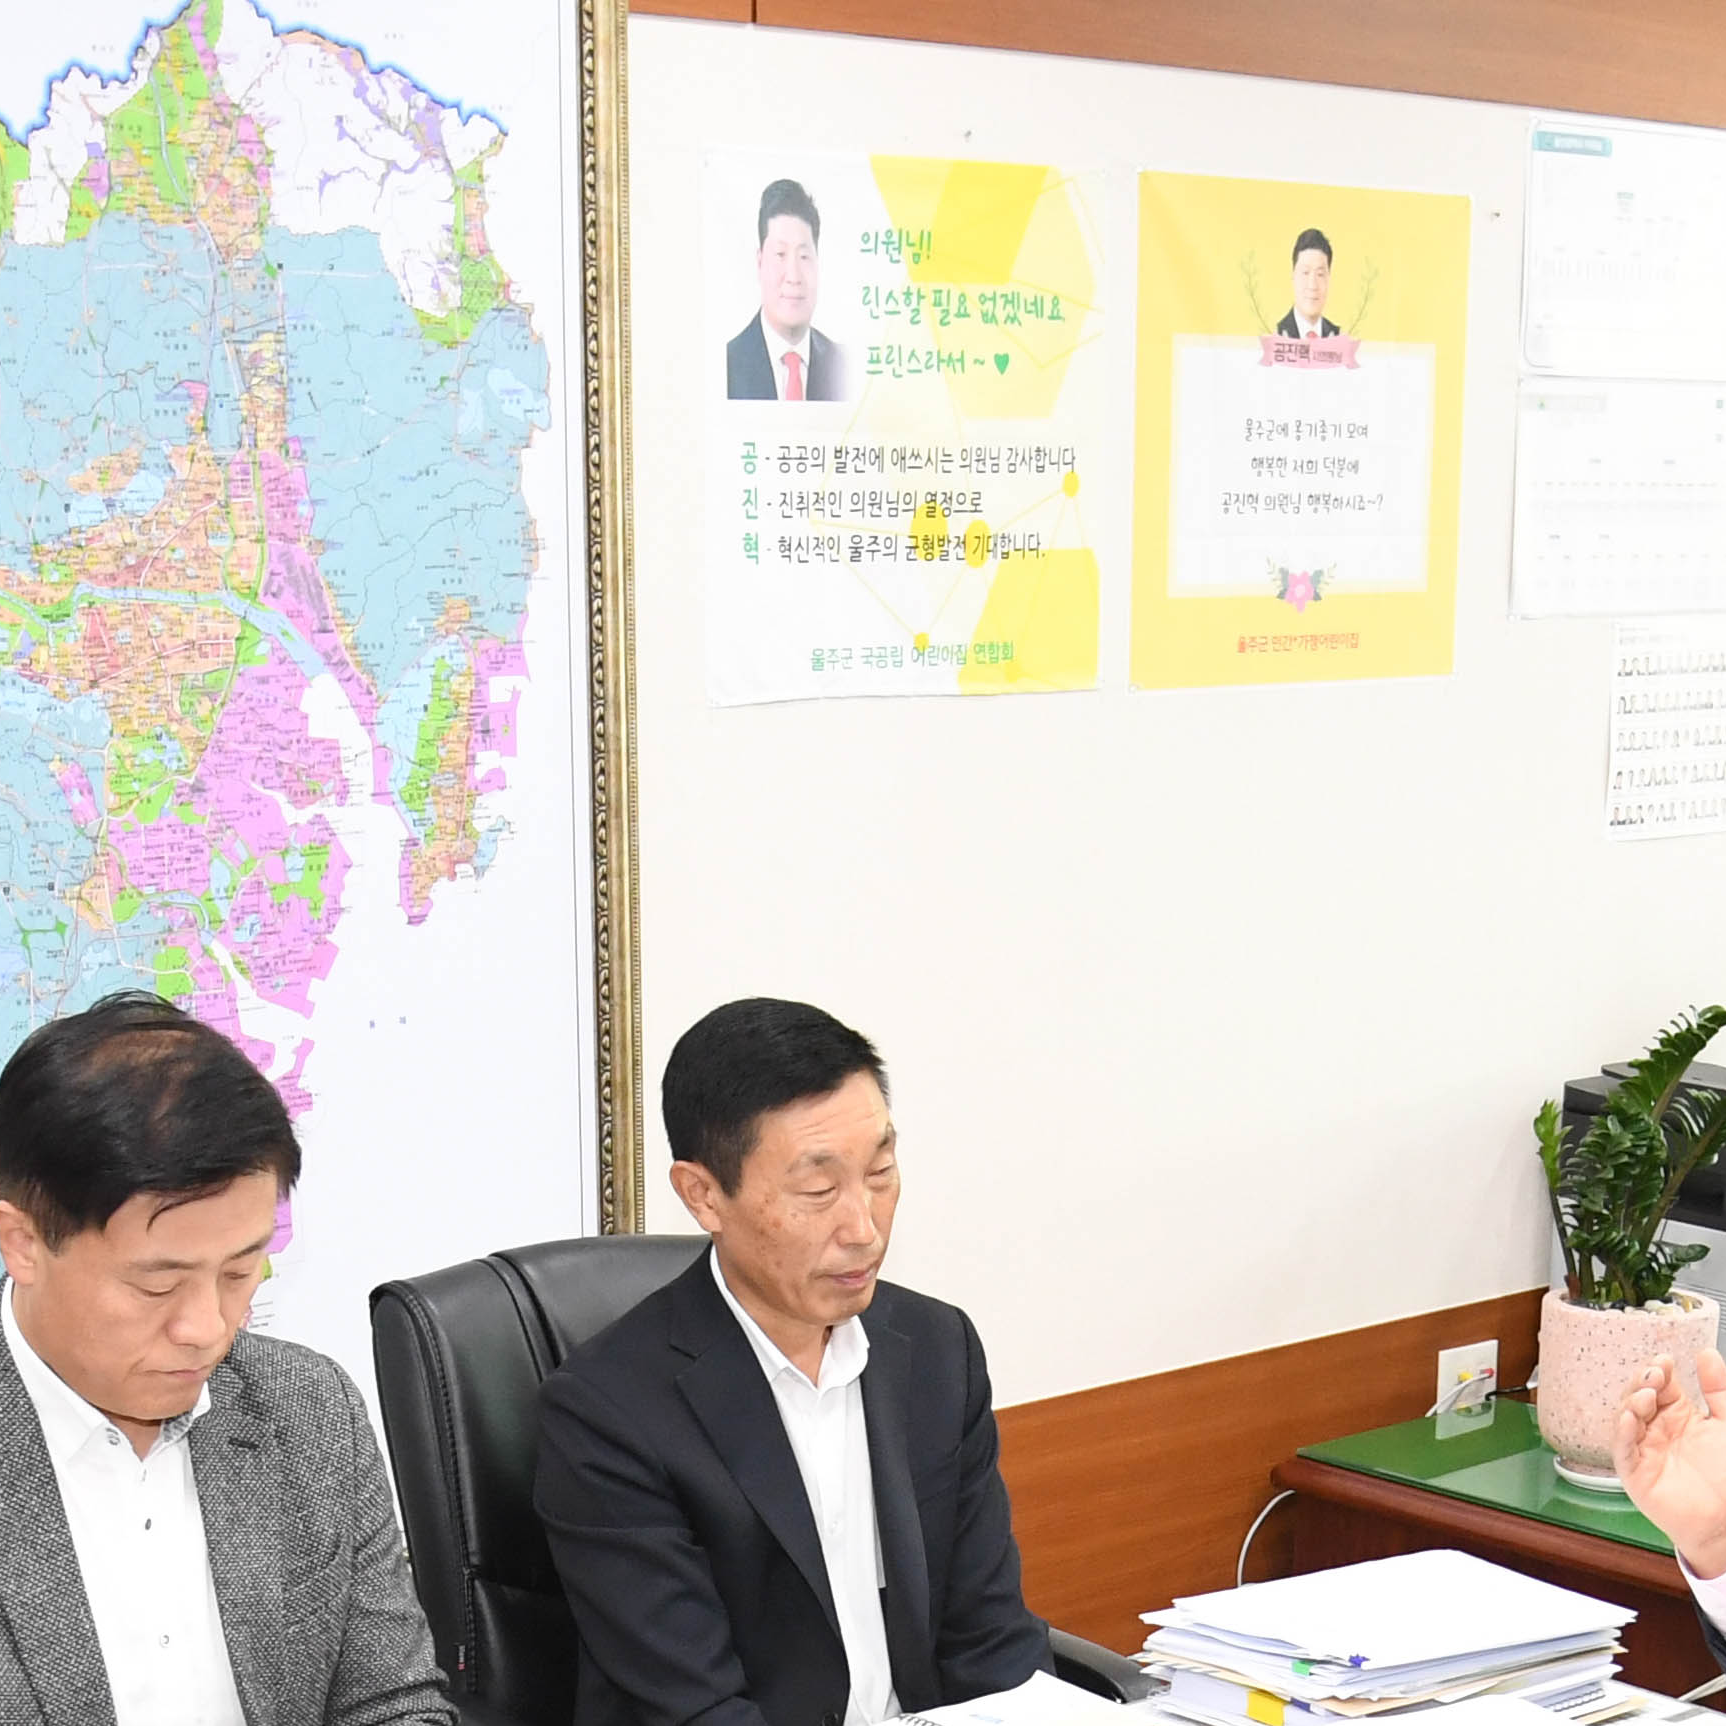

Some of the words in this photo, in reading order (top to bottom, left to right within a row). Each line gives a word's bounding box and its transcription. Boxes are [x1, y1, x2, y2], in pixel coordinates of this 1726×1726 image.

[860, 228, 933, 265] 의원님!
[862, 286, 925, 325] 린스할
[932, 289, 971, 327] 필요
[866, 345, 966, 378] 프린스라서
[1274, 342, 1311, 363] 공진혁
[1244, 418, 1289, 442] 울주군에
[1346, 423, 1369, 439] 모여
[740, 442, 759, 475] 공
[777, 445, 826, 474] 공공의
[834, 445, 885, 473] 발전에
[891, 447, 954, 473] 애쓰시는
[959, 446, 1001, 473] 의원님
[1006, 445, 1076, 473] 감사합니다
[1251, 456, 1288, 478] 행복한
[1293, 459, 1318, 475] 저희
[1323, 456, 1360, 478] 덕분에
[741, 487, 759, 520] 진
[778, 491, 843, 519] 진취적인
[850, 490, 918, 519] 의원님의
[924, 489, 984, 518] 열정으로
[1222, 492, 1259, 515] 공진혁
[1264, 492, 1302, 514] 의원님
[742, 532, 760, 565] 혁
[778, 535, 841, 564] 혁신적인
[848, 533, 899, 562] 울주의
[972, 531, 1046, 560] 기대합니다.
[810, 647, 854, 672] 울주군
[860, 645, 904, 669] 국공립
[912, 643, 968, 667] 어린이집
[973, 641, 1015, 665] 연합회
